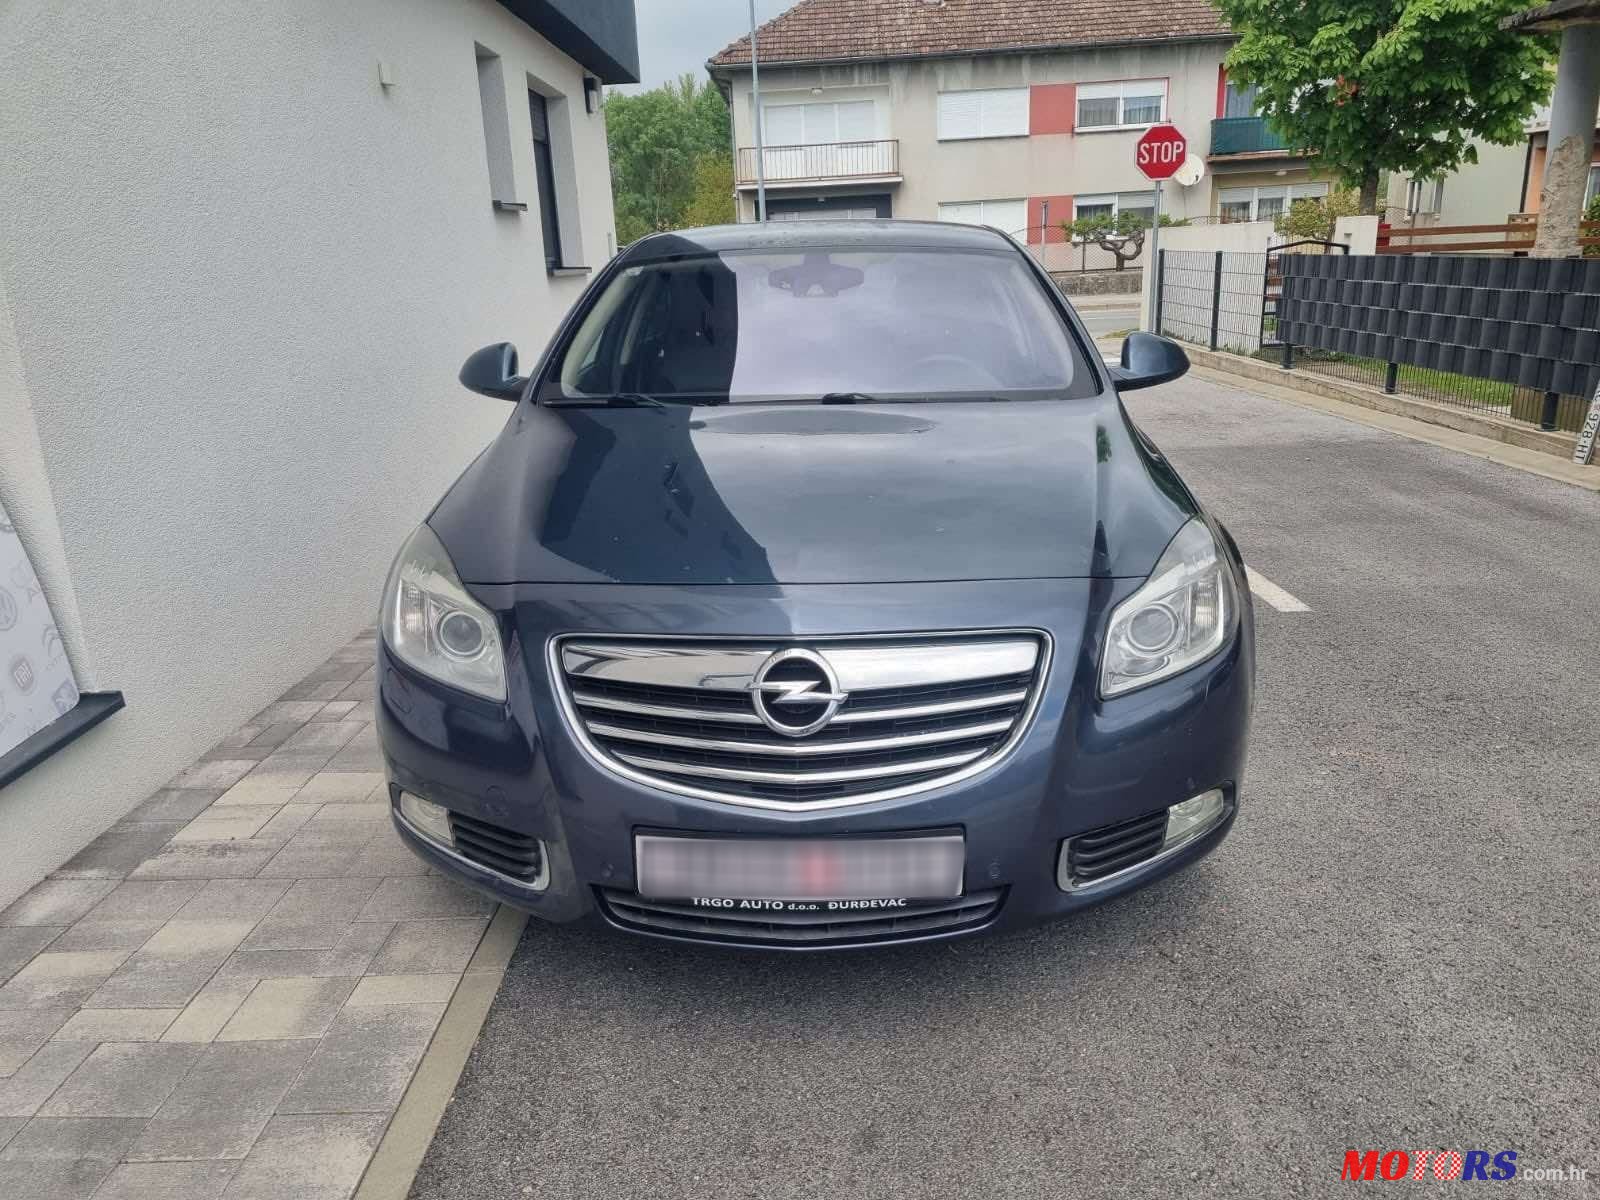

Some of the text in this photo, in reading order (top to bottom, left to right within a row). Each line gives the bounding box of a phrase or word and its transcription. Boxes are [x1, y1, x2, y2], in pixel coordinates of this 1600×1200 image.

[1139, 141, 1184, 164] STOP
[692, 897, 907, 911] TRGO AUTO d.o.o. ĐURĐEVAC
